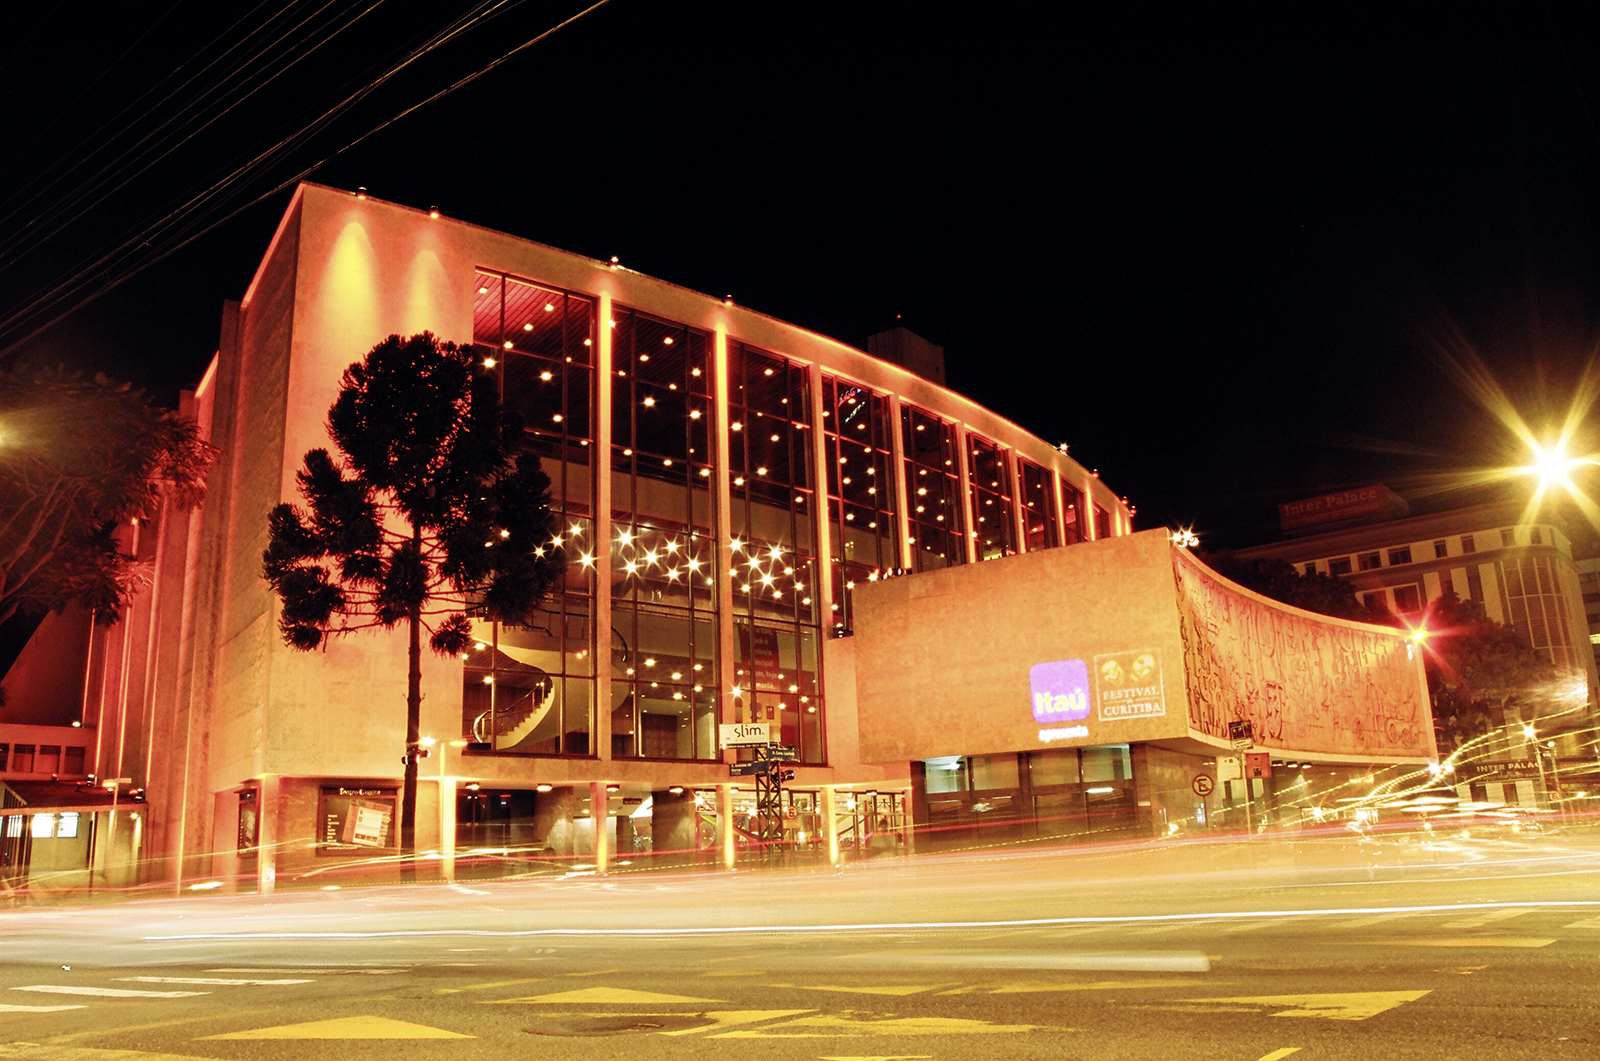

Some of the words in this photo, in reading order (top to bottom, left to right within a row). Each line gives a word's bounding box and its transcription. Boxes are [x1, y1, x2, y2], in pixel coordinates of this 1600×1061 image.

[1284, 500, 1322, 516] Inter
[1325, 490, 1377, 508] Palace
[1036, 688, 1086, 714] Itaú
[1103, 686, 1160, 701] FESTIVAL
[1103, 702, 1162, 717] CURITIBA
[1038, 725, 1089, 744] apresenta
[1476, 764, 1505, 773] INTER
